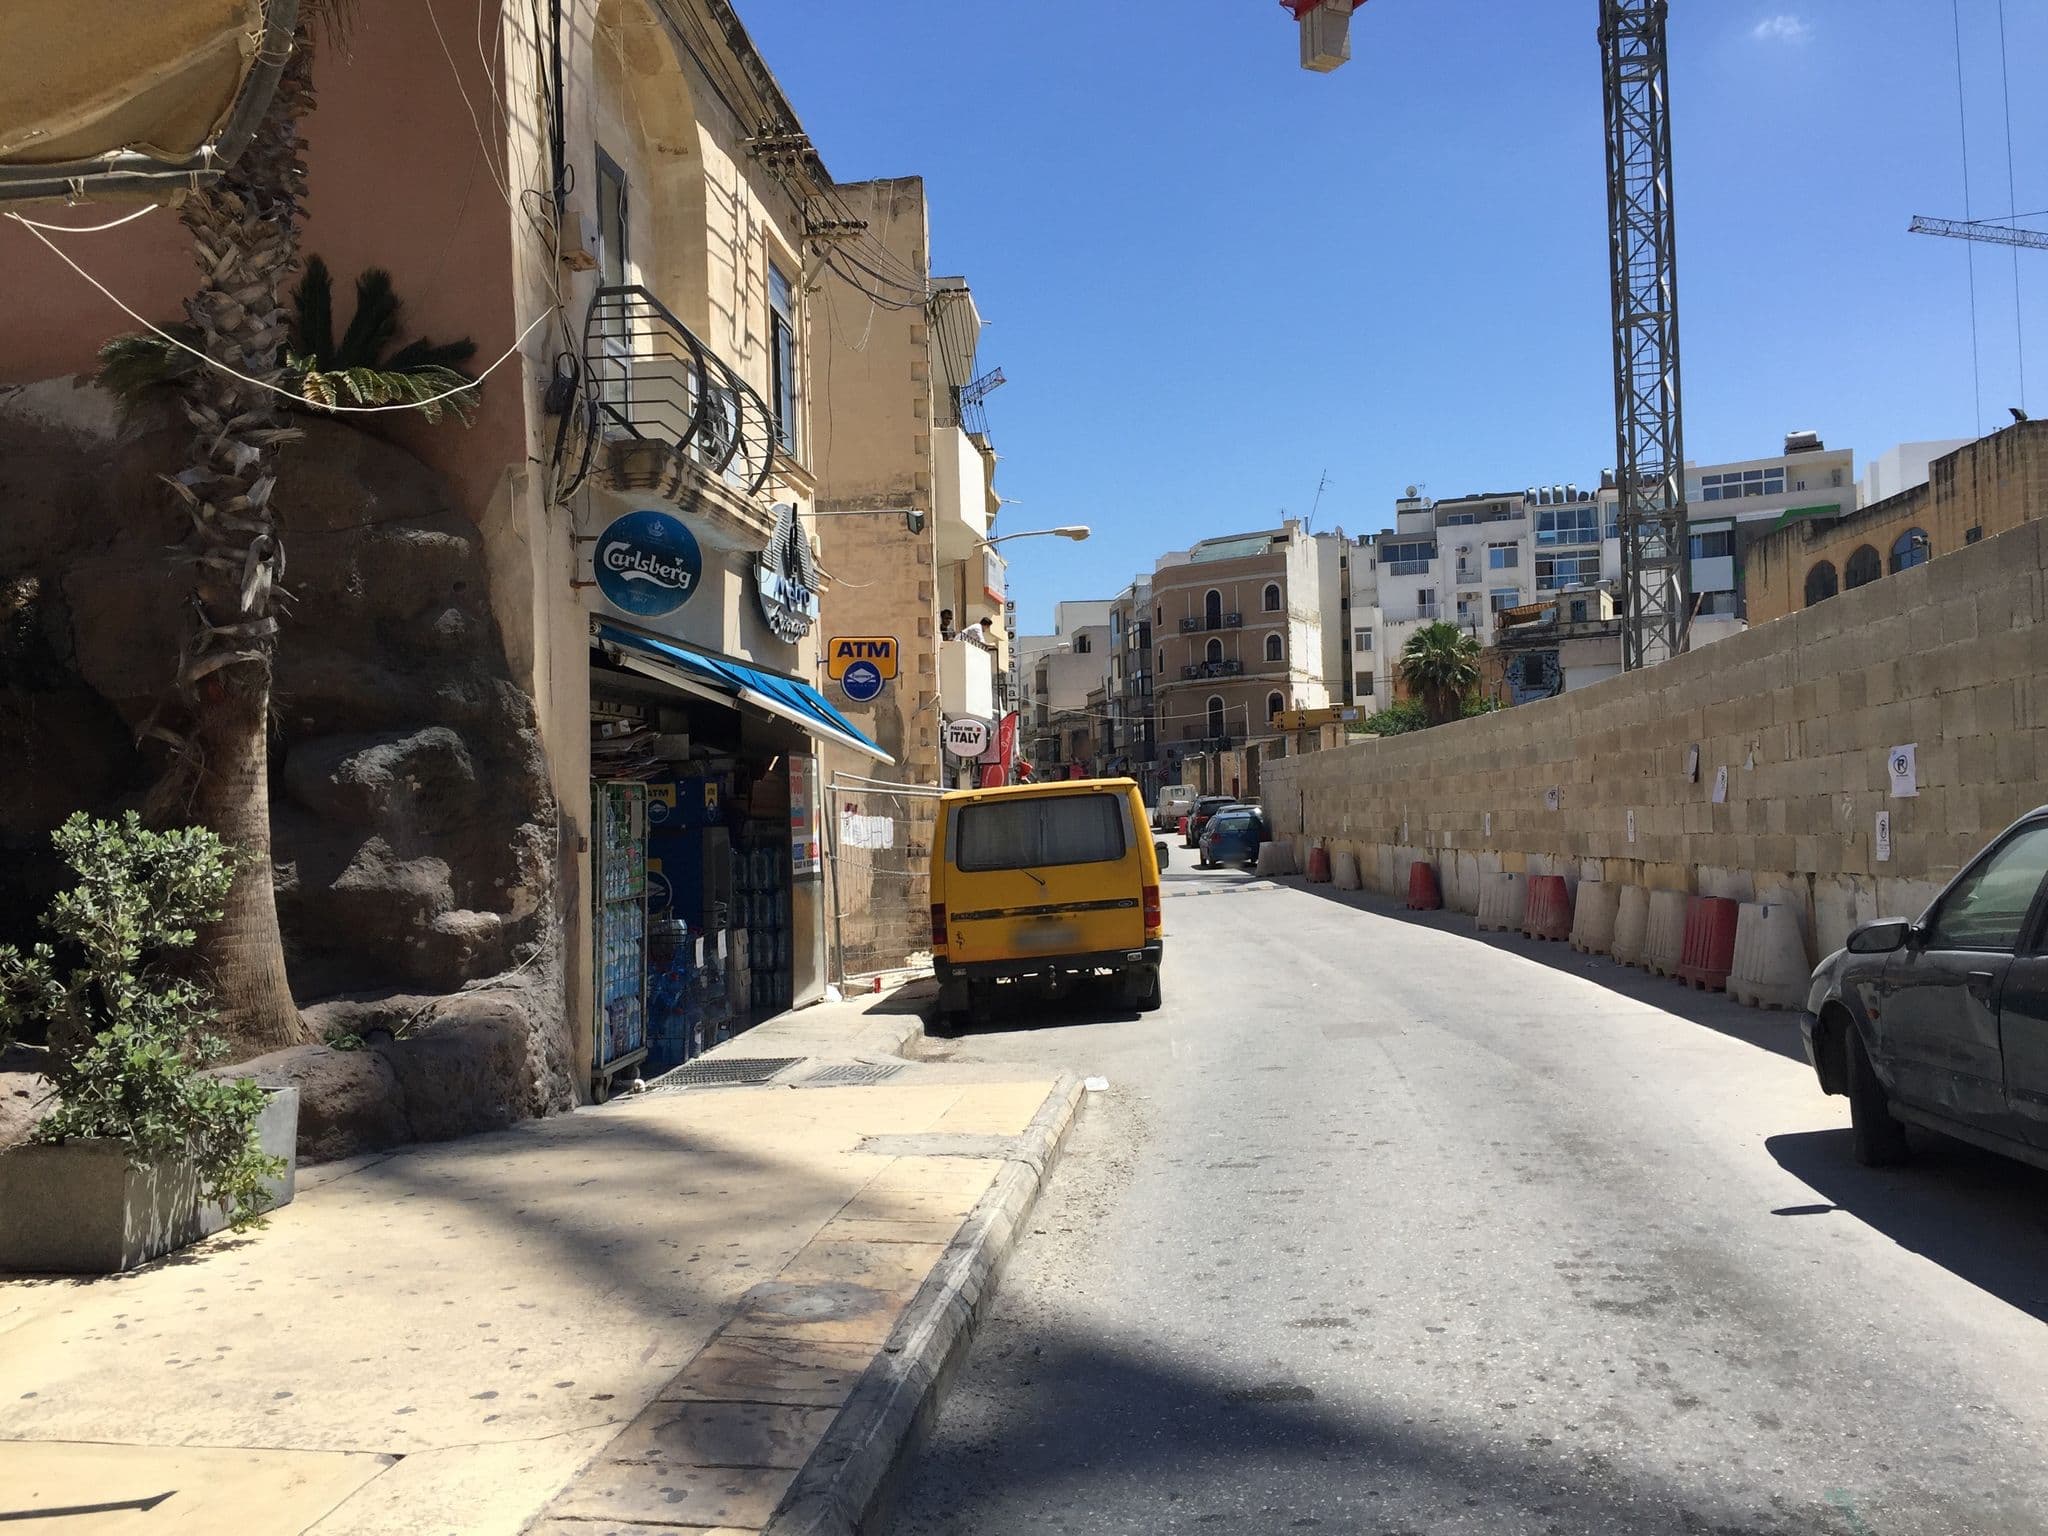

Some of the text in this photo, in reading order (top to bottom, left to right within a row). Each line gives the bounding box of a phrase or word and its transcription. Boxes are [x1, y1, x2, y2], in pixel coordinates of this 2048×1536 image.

[603, 541, 692, 589] Carlsberg
[836, 641, 890, 658] ATM
[950, 731, 981, 745] ITALY
